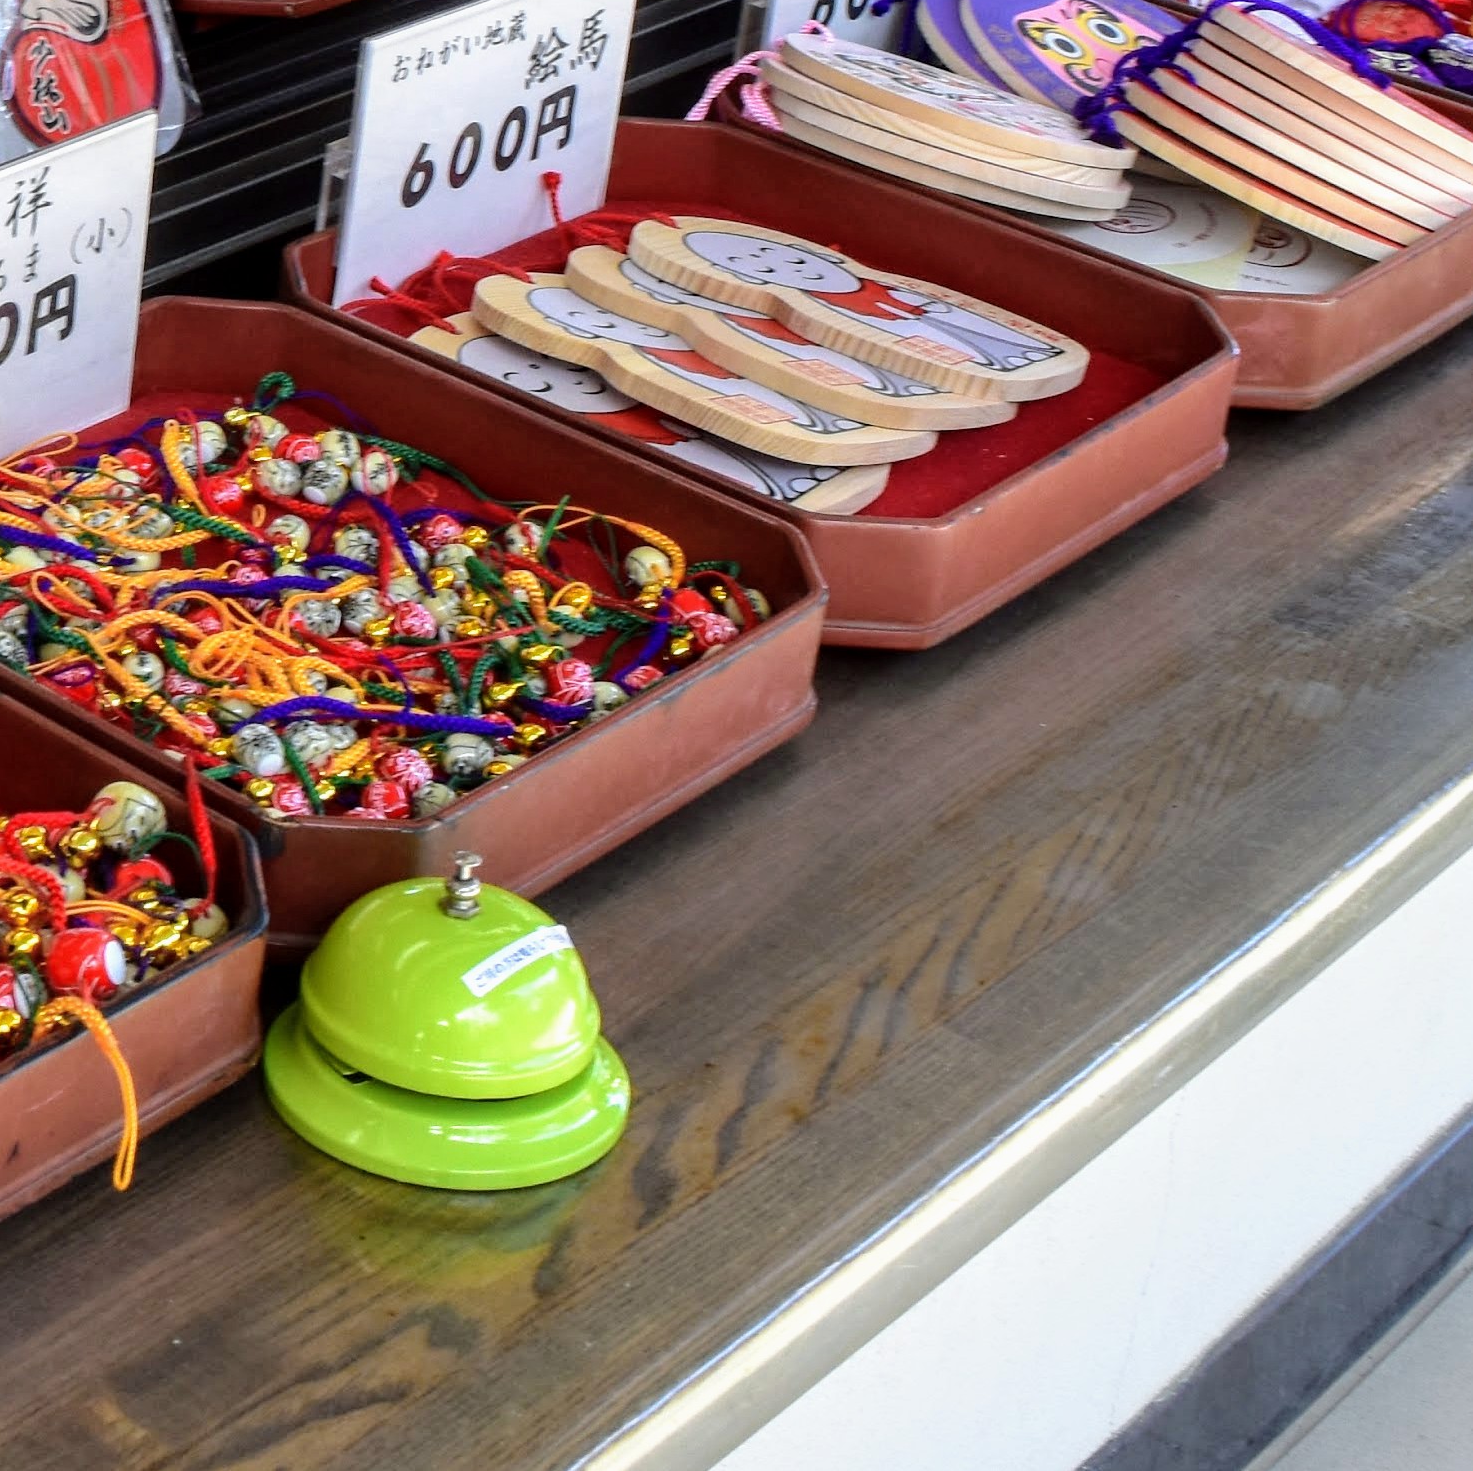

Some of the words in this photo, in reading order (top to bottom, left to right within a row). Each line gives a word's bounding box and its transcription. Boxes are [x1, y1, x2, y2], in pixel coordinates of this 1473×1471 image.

[391, 8, 528, 83] おねがい地蔵
[524, 7, 609, 90] 絵馬
[400, 83, 578, 210] 600円
